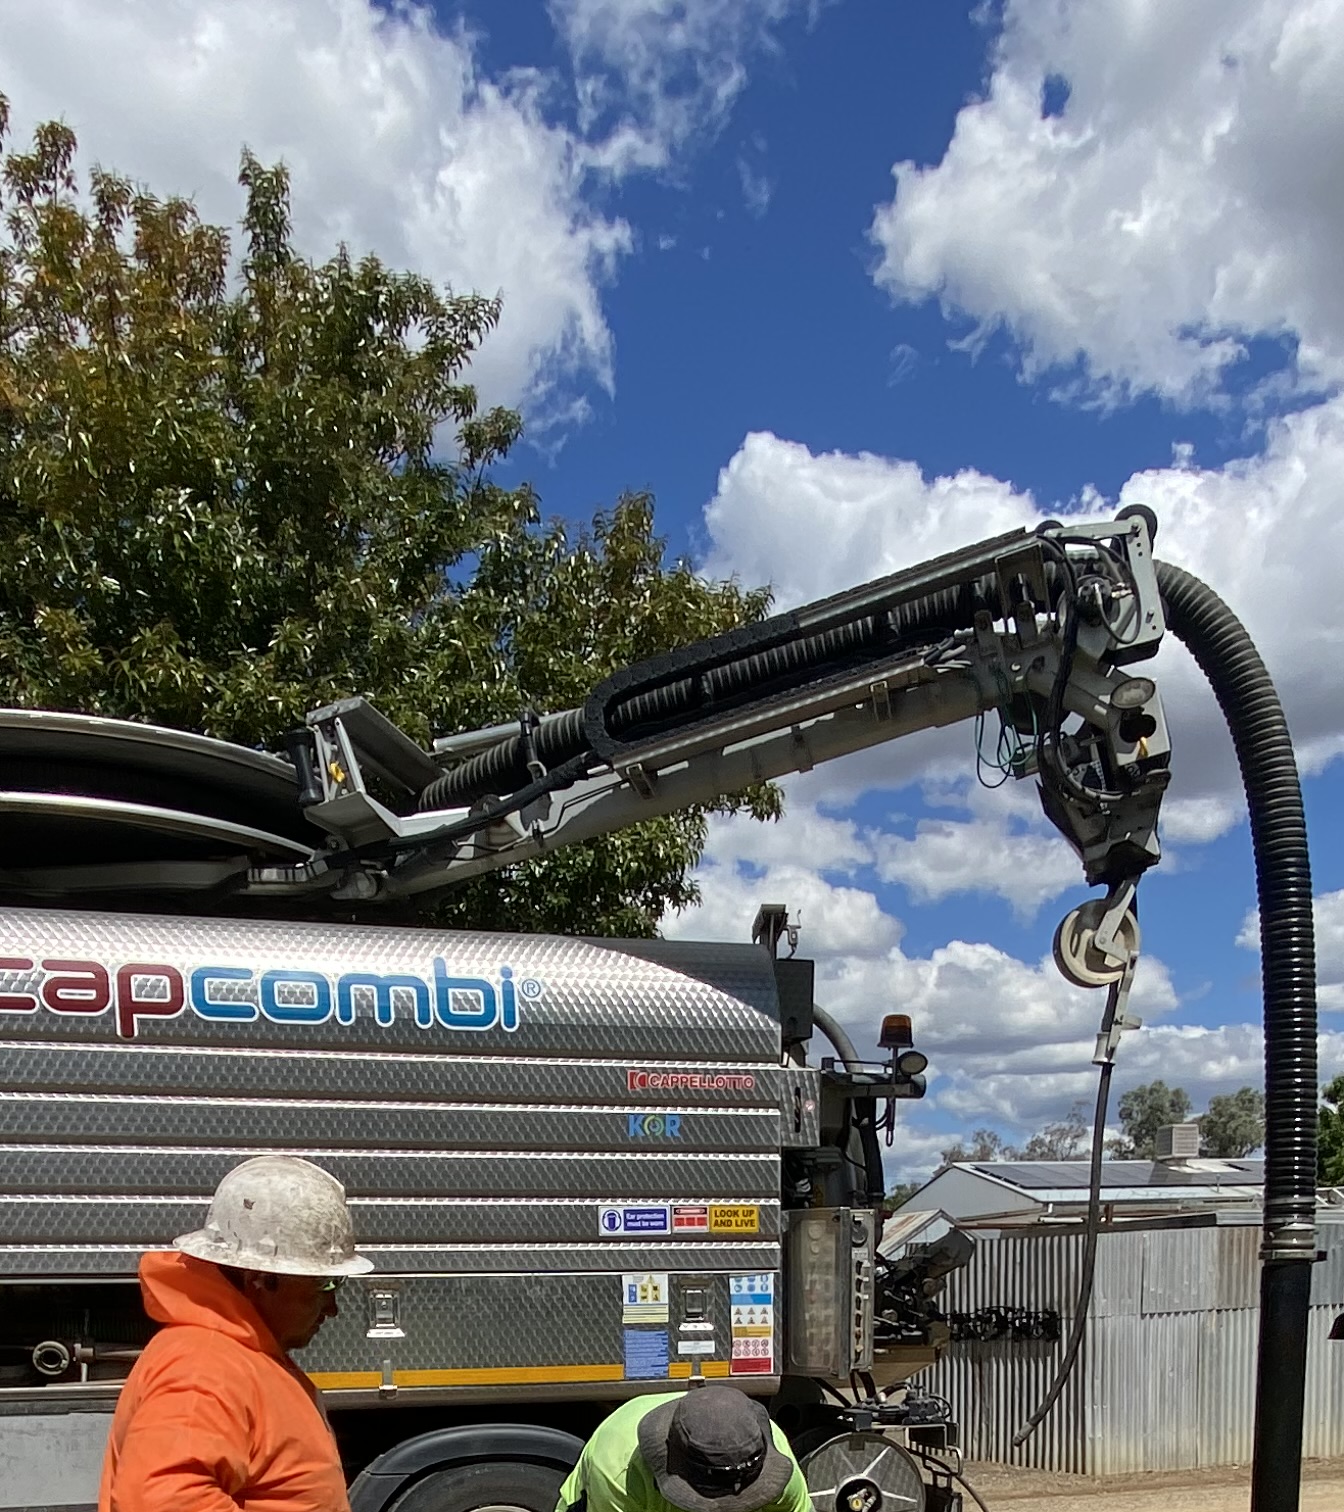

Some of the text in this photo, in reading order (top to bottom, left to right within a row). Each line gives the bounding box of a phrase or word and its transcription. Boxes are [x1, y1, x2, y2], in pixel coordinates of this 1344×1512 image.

[650, 1072, 755, 1089] CAPPELLOTTO
[714, 1209, 740, 1218] LOOK
[742, 1209, 755, 1218] UP
[713, 1218, 733, 1227] AND
[734, 1218, 756, 1227] LIVE
